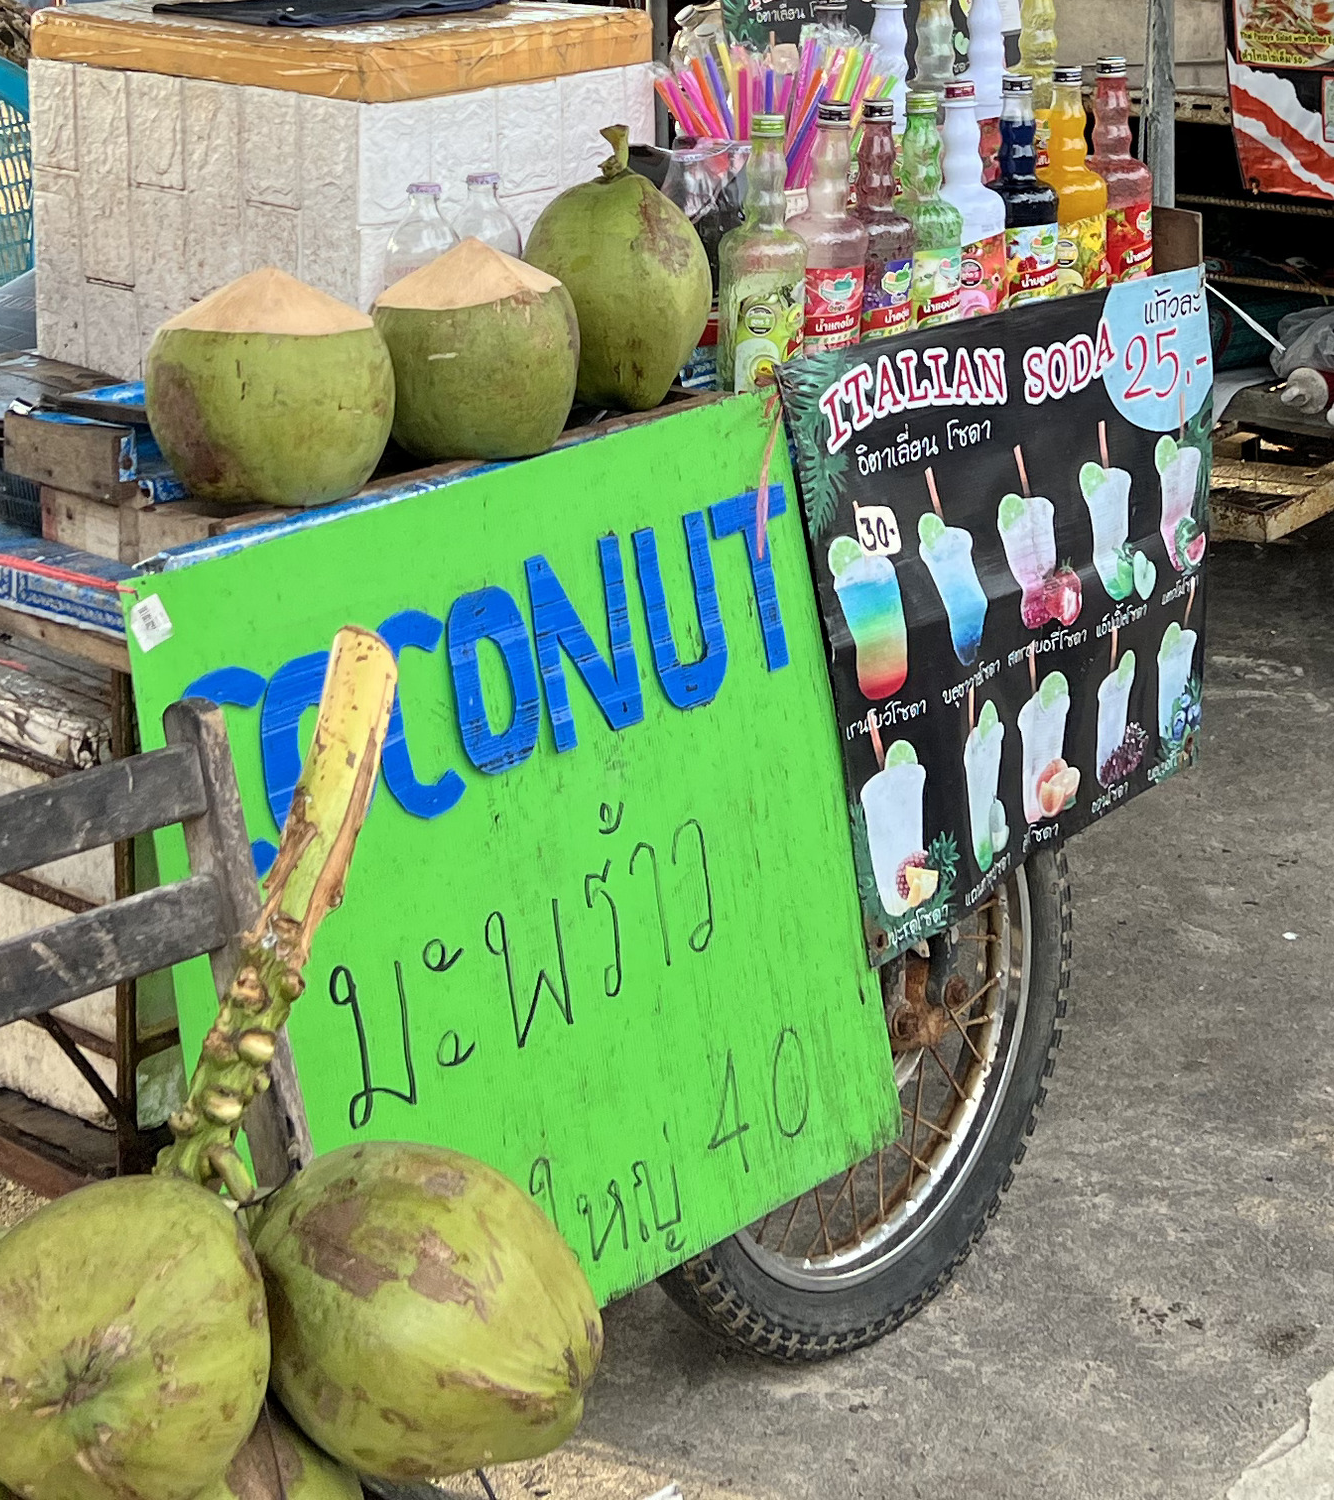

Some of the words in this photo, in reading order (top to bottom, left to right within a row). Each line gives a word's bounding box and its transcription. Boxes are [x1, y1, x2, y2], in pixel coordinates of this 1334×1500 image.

[1144, 288, 1202, 325] แก้วละ
[819, 347, 1008, 454] ITALIAN
[1023, 317, 1115, 404] SODA
[855, 422, 939, 476] อิตาเลี่ยน
[946, 418, 993, 453] โซดา
[329, 802, 714, 1130] มะพร้าว
[707, 1028, 809, 1173] 40
